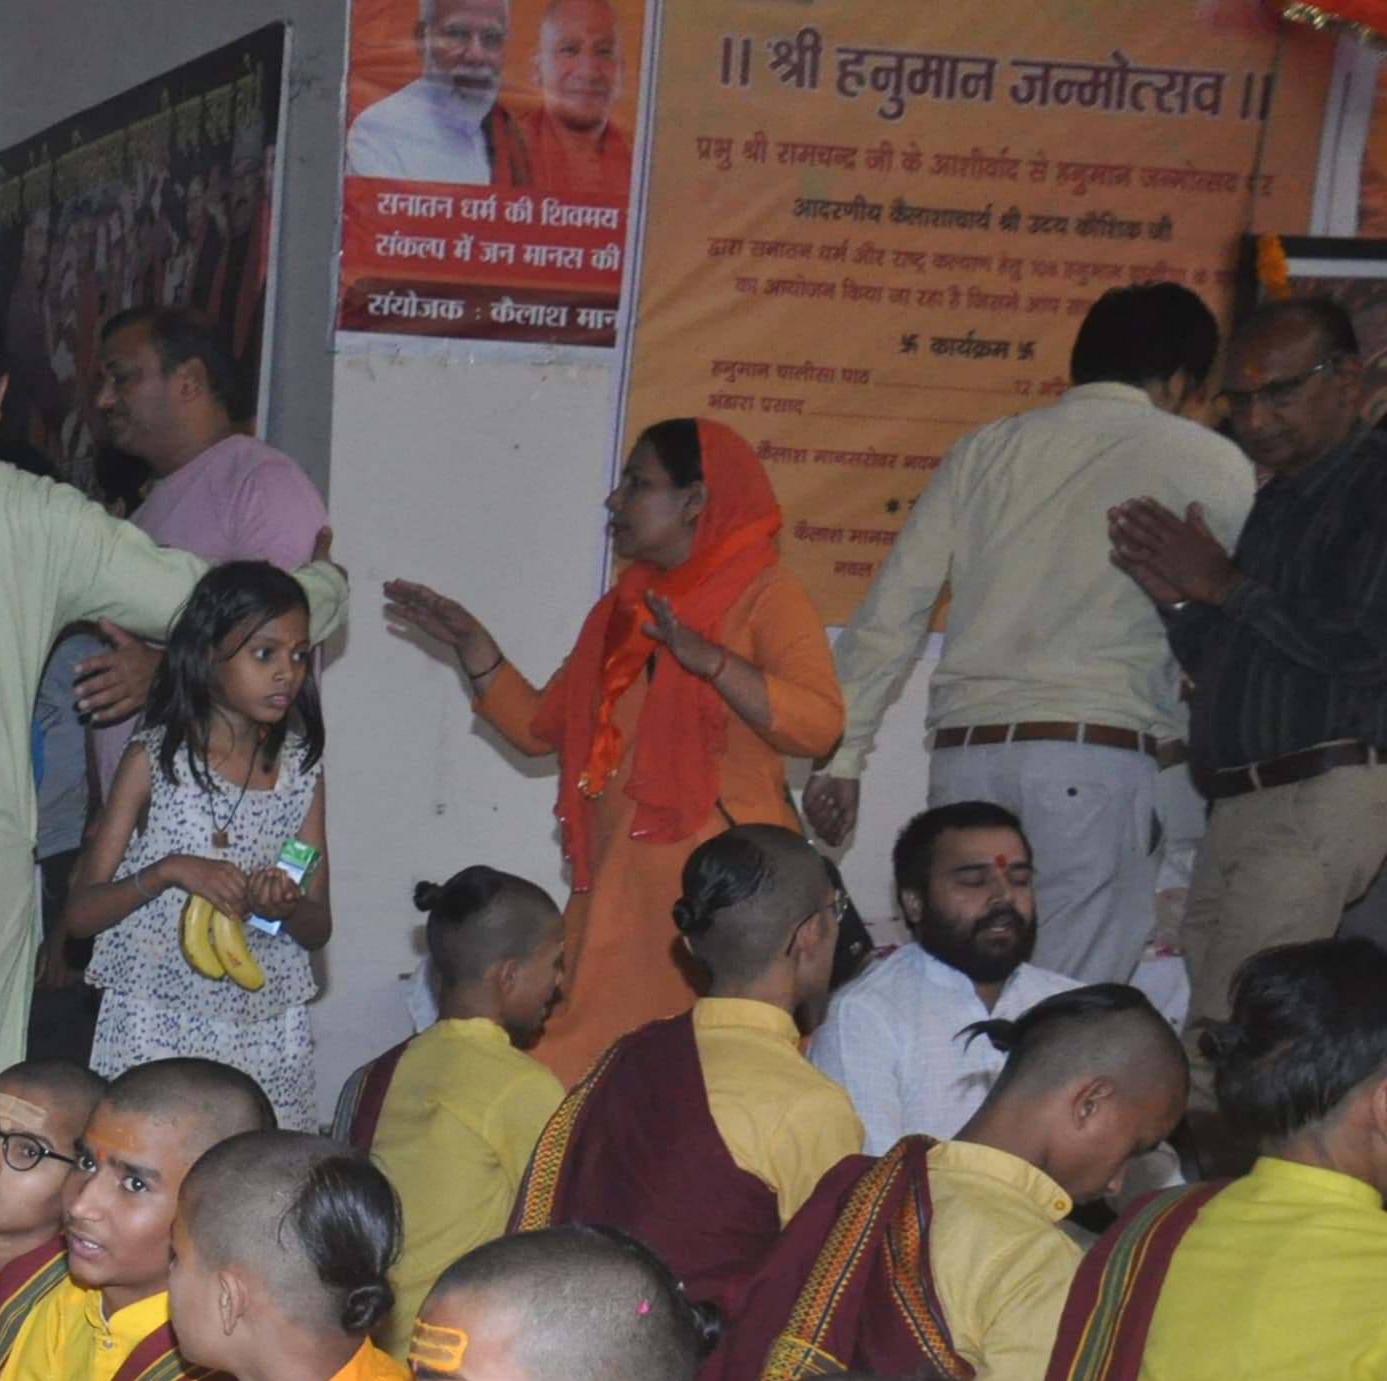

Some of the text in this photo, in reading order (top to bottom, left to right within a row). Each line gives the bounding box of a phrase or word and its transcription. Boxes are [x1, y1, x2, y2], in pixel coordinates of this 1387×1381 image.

[767, 27, 823, 90] श्री
[835, 45, 999, 122] हनुमान
[1009, 47, 1227, 116] जन्मोत्सव
[696, 136, 734, 171] प्रभु
[742, 131, 769, 165] श्री
[776, 141, 858, 171] रामचन्द्र
[865, 139, 894, 173] जी
[902, 141, 923, 173] के
[930, 146, 1021, 181] आशीर्वाद
[1027, 148, 1049, 183] से
[1056, 160, 1133, 196] हनुमान
[376, 191, 454, 220] सनातन
[461, 194, 497, 223] धर्म
[504, 196, 533, 224] की
[792, 194, 883, 223] आदरणीय
[999, 204, 1021, 234] श्री
[375, 230, 621, 273] संकल्प में जन मानस की
[366, 288, 466, 322] संयोजक
[489, 294, 569, 328] कैलाश
[929, 330, 1012, 359] कार्यक्रम
[710, 358, 770, 384] हनुमान
